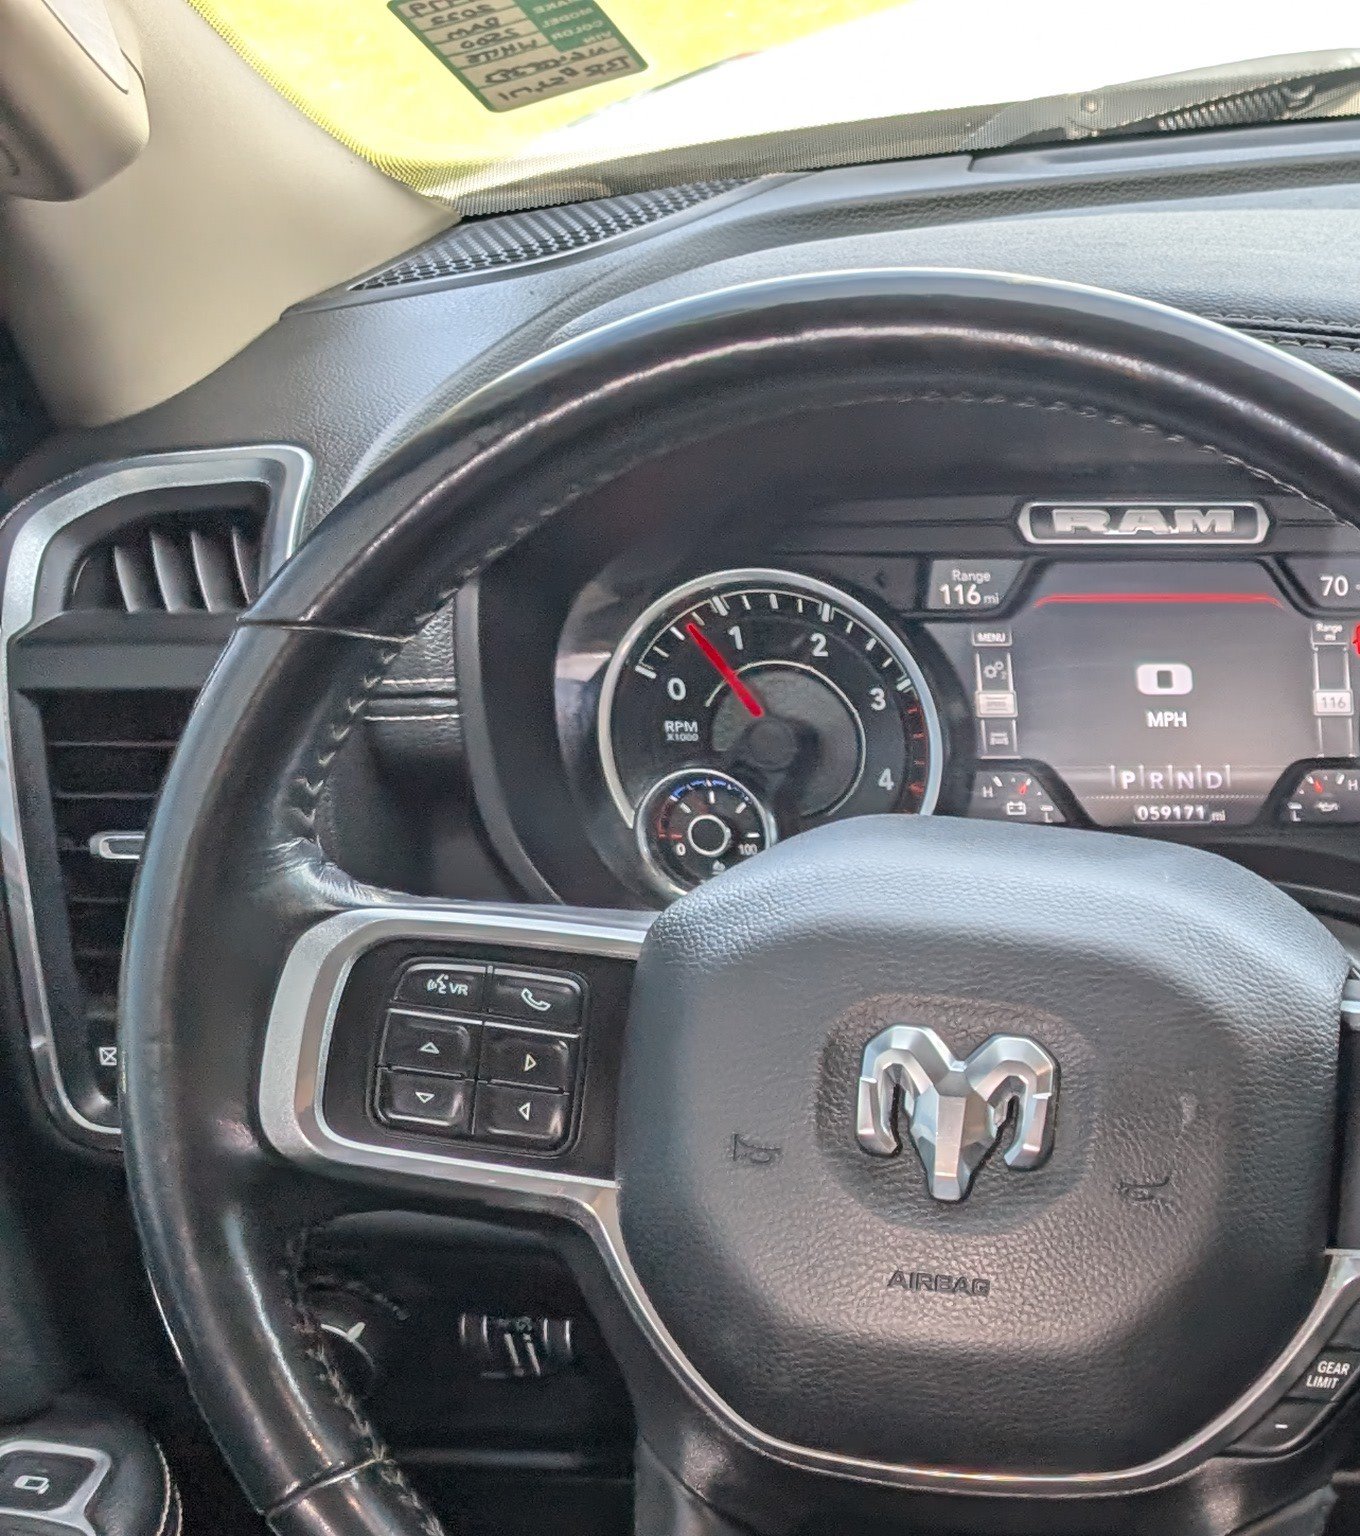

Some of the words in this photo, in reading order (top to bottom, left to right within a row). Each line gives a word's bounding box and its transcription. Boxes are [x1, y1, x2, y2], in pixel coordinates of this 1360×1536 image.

[1051, 508, 1237, 535] RAM
[952, 569, 991, 585] Range
[940, 585, 982, 605] 116
[983, 592, 1000, 605] mi
[1320, 576, 1348, 597] 70
[1316, 622, 1343, 633] Range
[729, 626, 745, 651] 1
[811, 633, 829, 658] 2
[1136, 663, 1193, 696] 0
[667, 677, 688, 701] 0
[869, 689, 887, 711] 3
[1321, 697, 1346, 709] 116
[664, 719, 699, 733] RPM
[1146, 711, 1188, 729] MPH
[877, 768, 895, 790] 4
[1122, 771, 1136, 789] P
[1149, 771, 1164, 789] R
[1177, 771, 1194, 789] N
[1206, 771, 1223, 789] D
[1137, 805, 1206, 822] 059171
[1211, 808, 1226, 823] mi
[675, 843, 686, 856] 0
[738, 843, 758, 856] 100
[449, 984, 469, 996] VR
[887, 1269, 991, 1297] AIRBAG
[1317, 1360, 1350, 1377] GEAR
[1306, 1375, 1339, 1390] LIMIT
